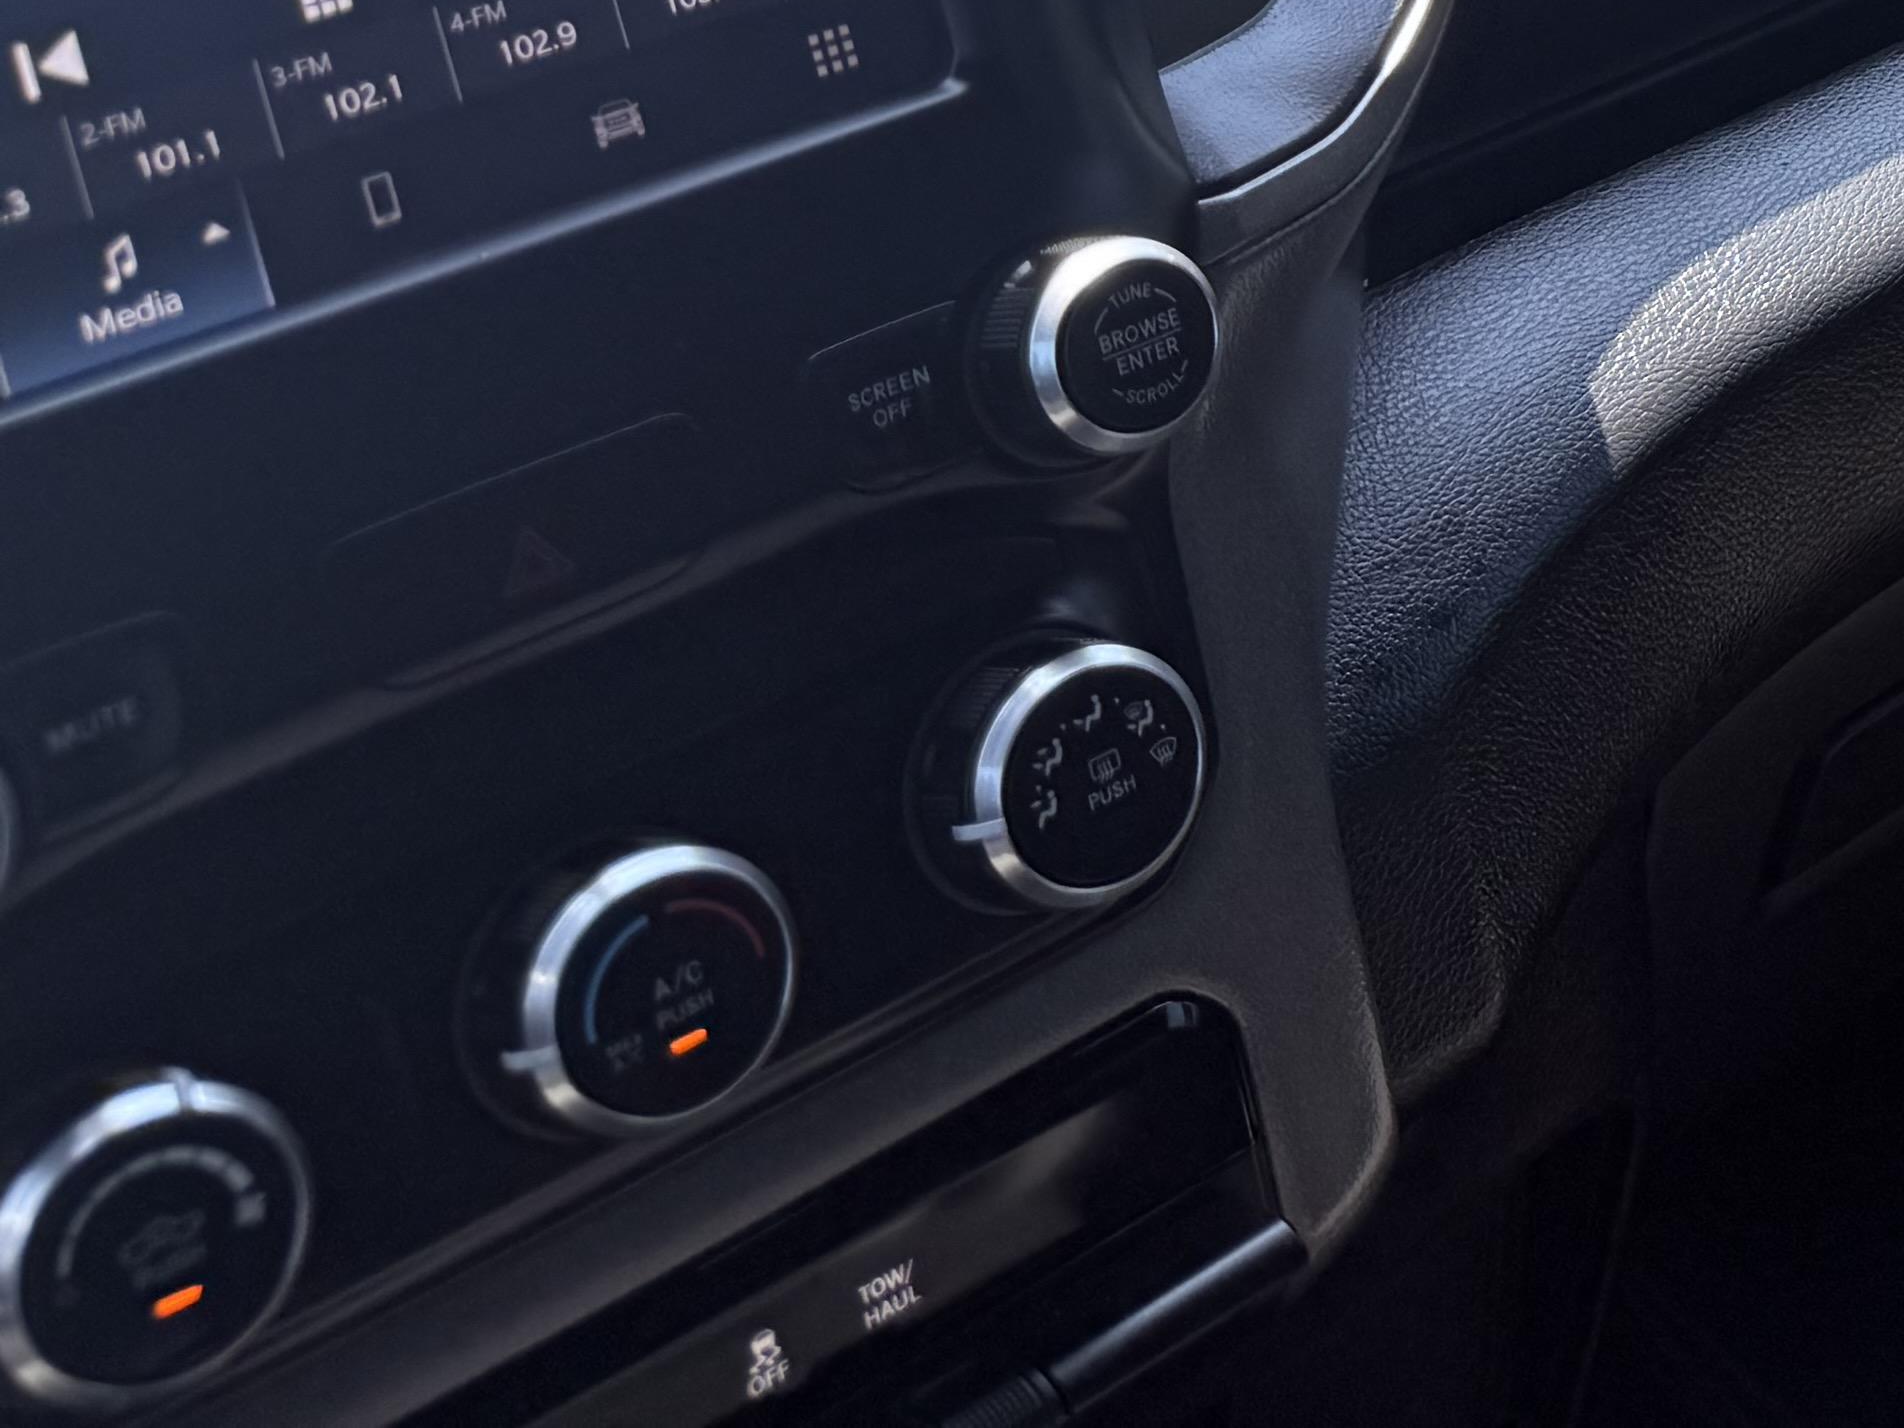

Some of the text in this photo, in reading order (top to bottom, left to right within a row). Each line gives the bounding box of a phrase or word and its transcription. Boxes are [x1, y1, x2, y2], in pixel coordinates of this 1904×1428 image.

[449, 0, 508, 33] 4-FM
[499, 20, 578, 67] 102.9
[270, 51, 334, 89] 3-FM
[323, 73, 403, 123] 102.1
[79, 106, 147, 149] 2-FM
[135, 129, 221, 180] 101.1
[79, 288, 184, 344] Media
[1106, 281, 1152, 309] TUNE
[1098, 307, 1181, 355] BROWSE
[1116, 335, 1181, 376] ENTER
[847, 364, 931, 413] SCREEN
[1124, 367, 1185, 405] SCROLL
[871, 397, 912, 429] OFF
[1087, 773, 1137, 811] PUSH
[857, 1257, 915, 1305] TOW/
[863, 1284, 923, 1331] HAUL
[747, 1356, 791, 1399] OFF
